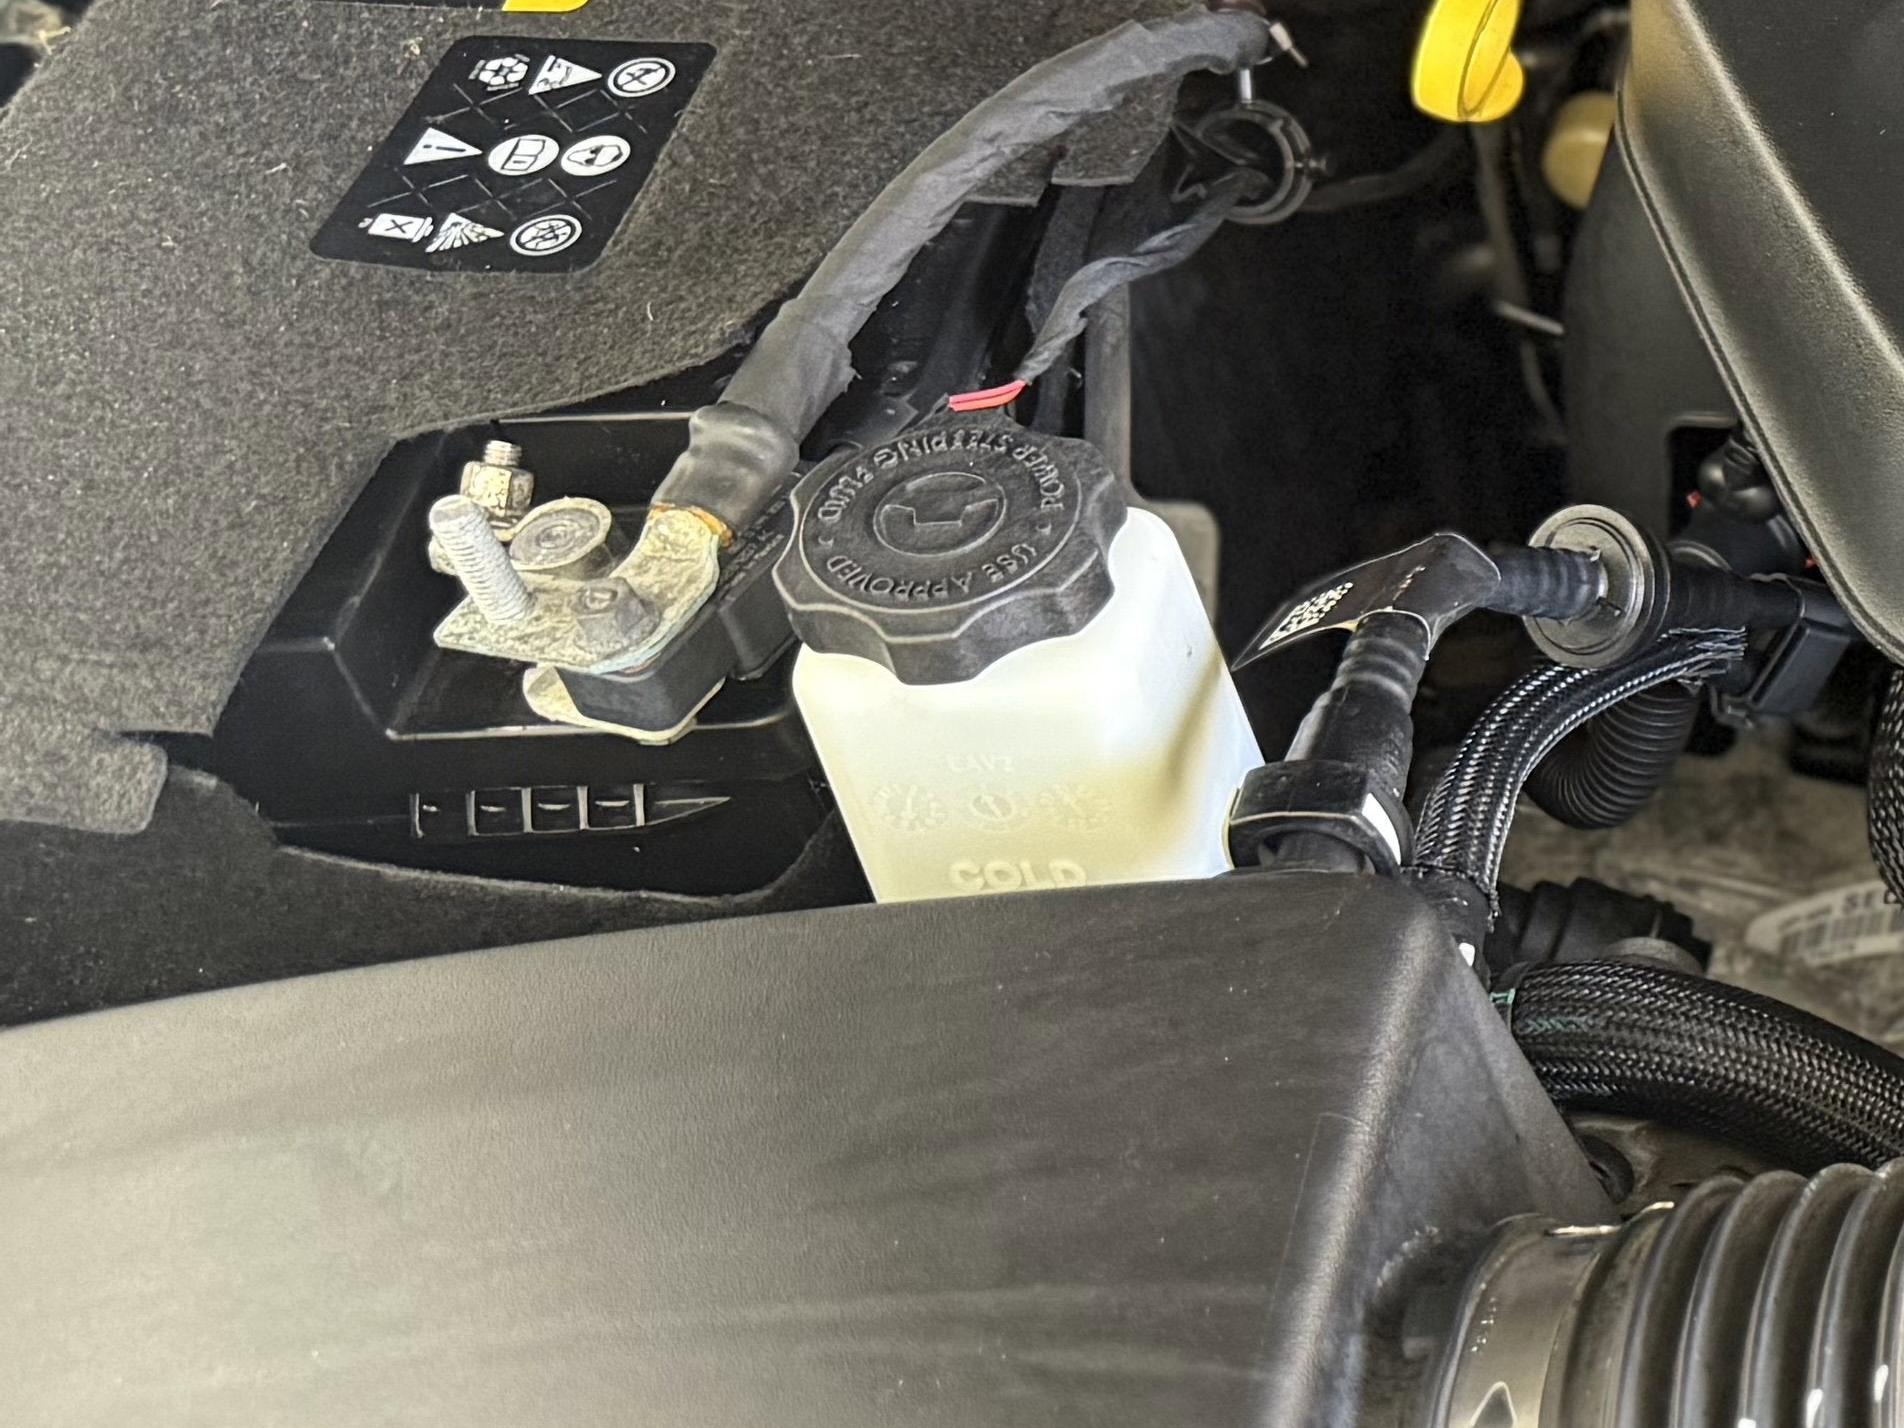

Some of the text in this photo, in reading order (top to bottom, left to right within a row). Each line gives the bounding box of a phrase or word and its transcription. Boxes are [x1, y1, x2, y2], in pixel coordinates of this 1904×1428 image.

[1012, 442, 1066, 513] POWER
[825, 543, 1038, 602] USE APPROVED
[947, 858, 1089, 893] COLD
